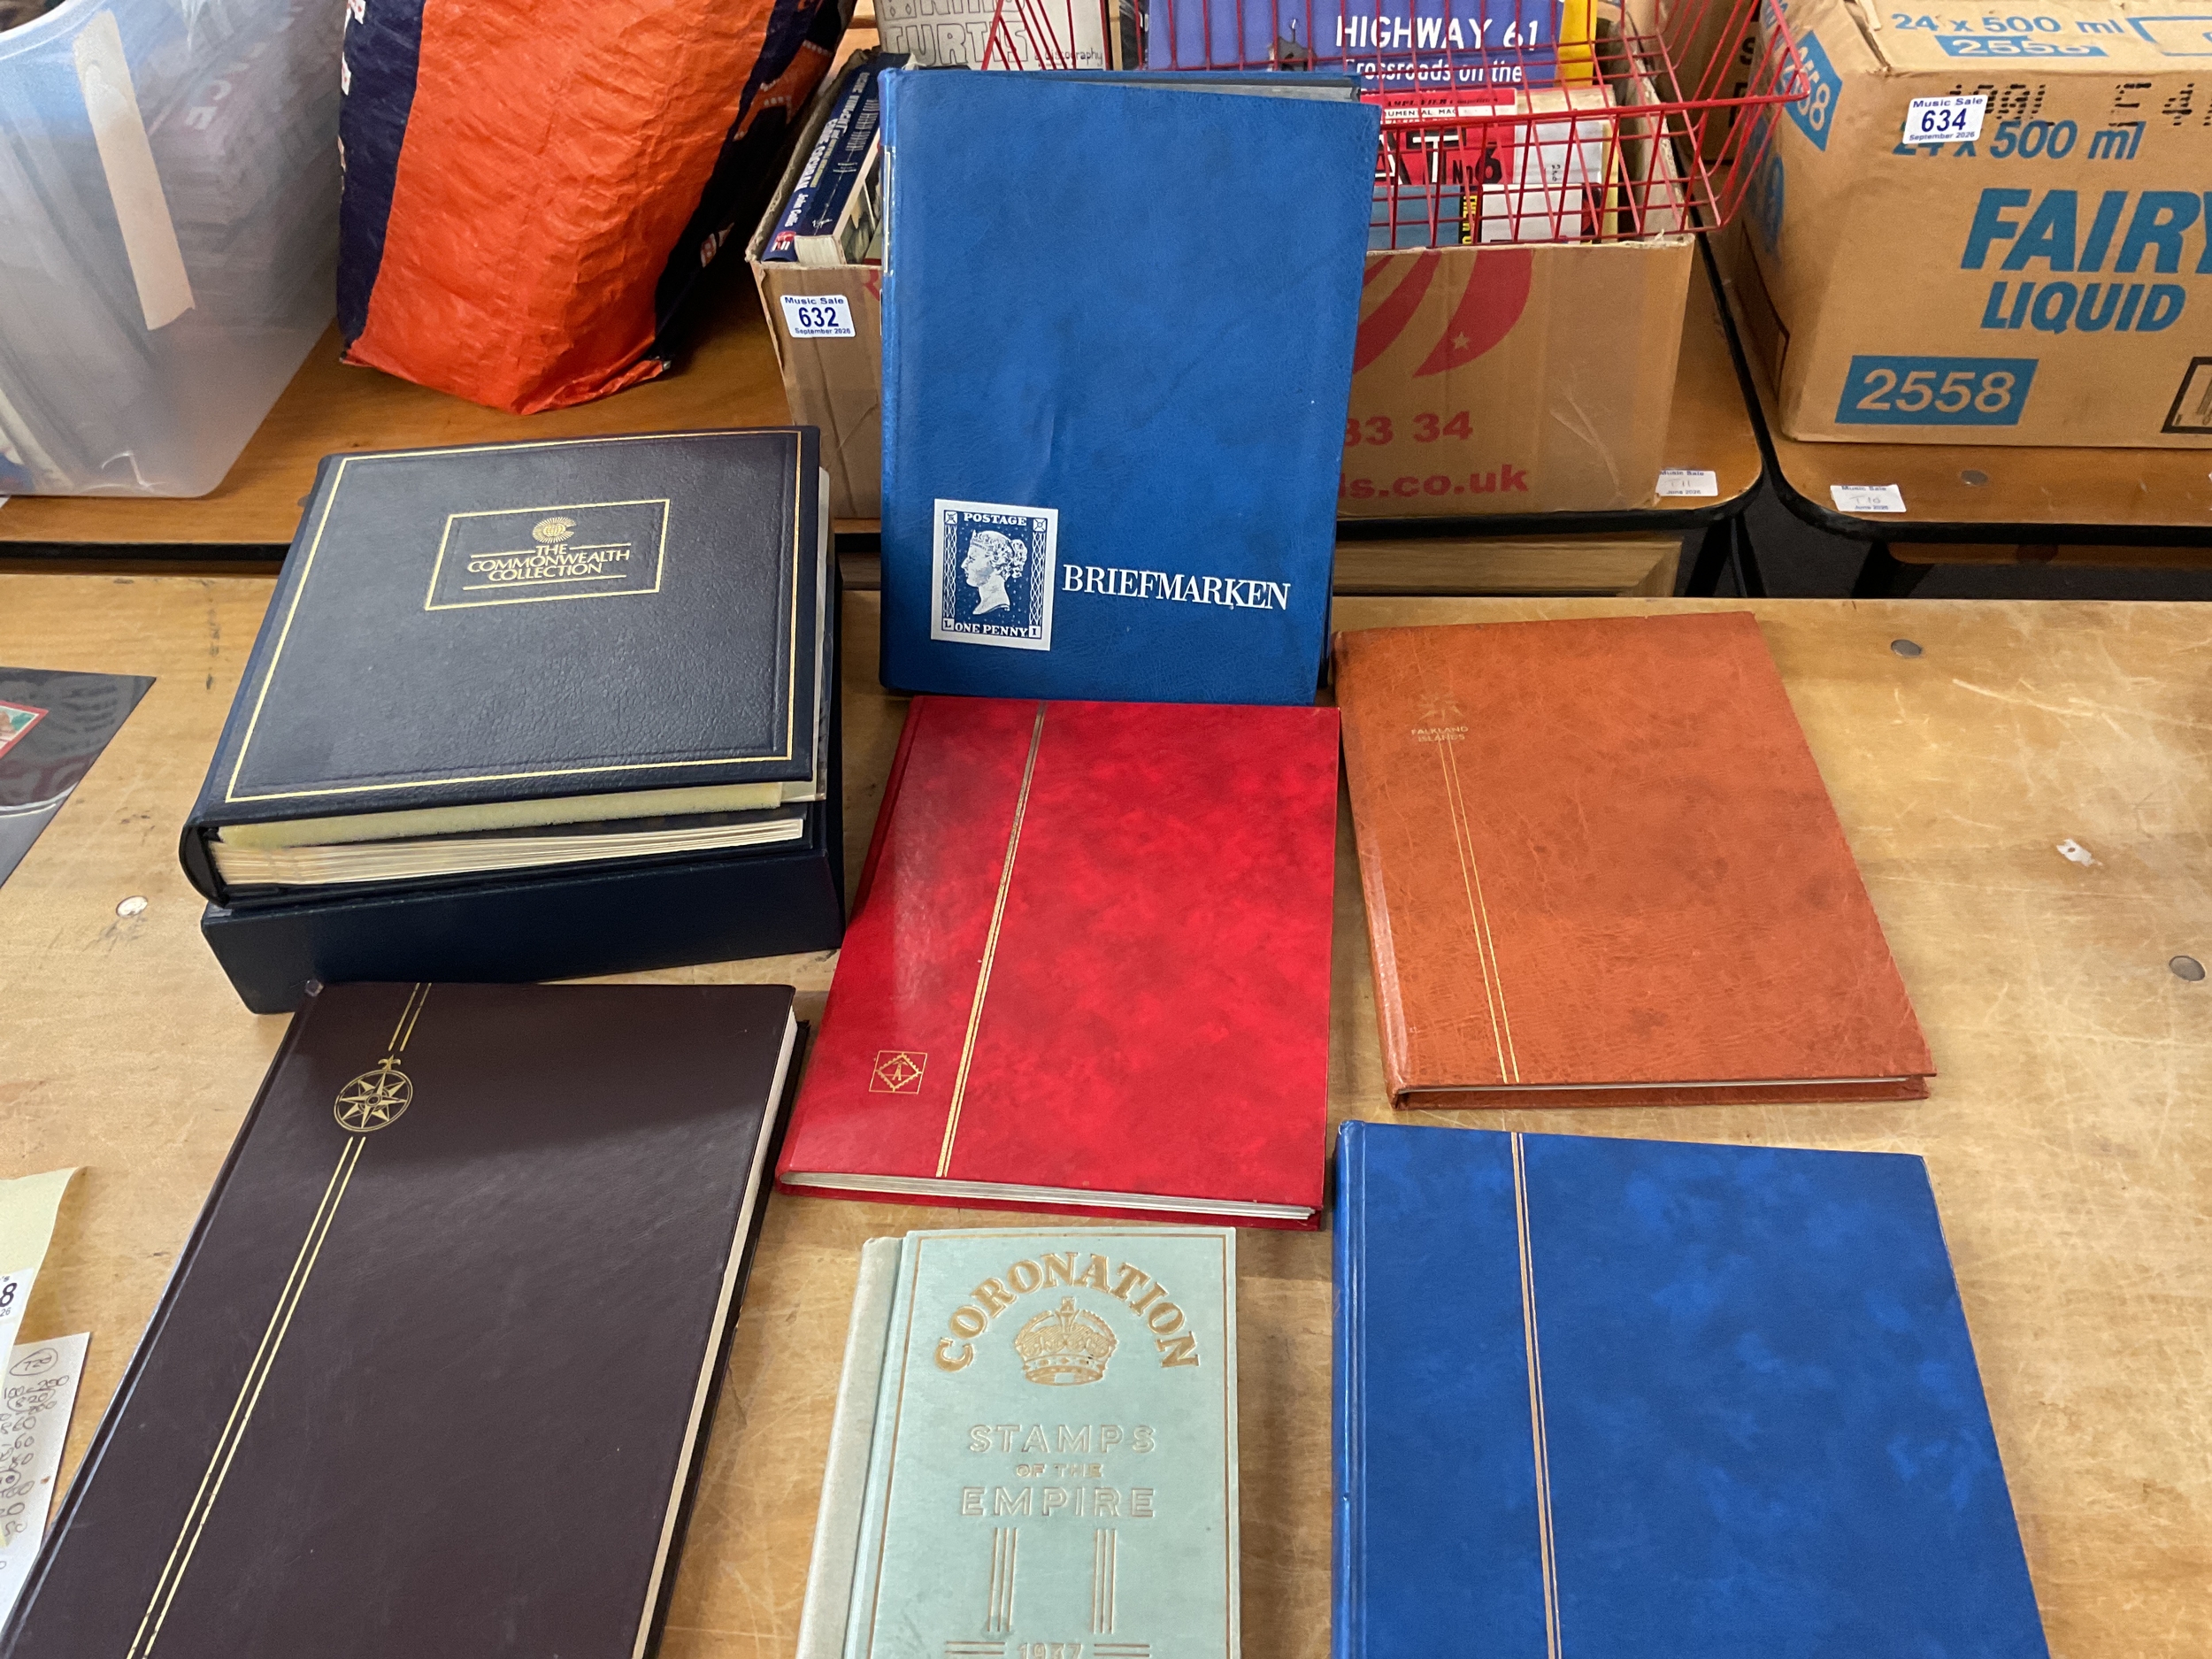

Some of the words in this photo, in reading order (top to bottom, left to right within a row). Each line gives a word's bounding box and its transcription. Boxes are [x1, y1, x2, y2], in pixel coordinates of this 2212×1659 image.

[1336, 16, 1493, 49] HIGHWAY
[1503, 20, 1538, 50] 61
[1892, 13, 1939, 32] 24
[1949, 19, 1974, 32] x
[1981, 17, 2062, 33] 500
[2076, 19, 2124, 34] ml
[1491, 60, 1522, 82] the
[1913, 99, 1951, 108] Music
[1921, 108, 1967, 132] 634
[1909, 133, 1954, 142] September
[1990, 119, 2078, 159] 500
[2087, 120, 2147, 159] ml
[798, 307, 839, 327] 632
[1981, 281, 2186, 334] LIQUID
[1856, 368, 2016, 412] 2558
[1413, 411, 1473, 442] 34
[964, 512, 1026, 526] POSTAGE
[467, 549, 630, 572] COMMONWEALTH
[535, 544, 568, 556] THE
[488, 562, 603, 581] COLLECTION
[1063, 564, 1291, 611] BRIEFMARKEN
[956, 622, 980, 634] ONE
[1418, 733, 1465, 742] ISLANDS
[934, 1251, 1200, 1372] CORONATION
[969, 1424, 1156, 1453] STAMPS
[1017, 1463, 1045, 1478] OF
[1055, 1463, 1103, 1478] THE
[961, 1486, 1156, 1517] EMPIRE
